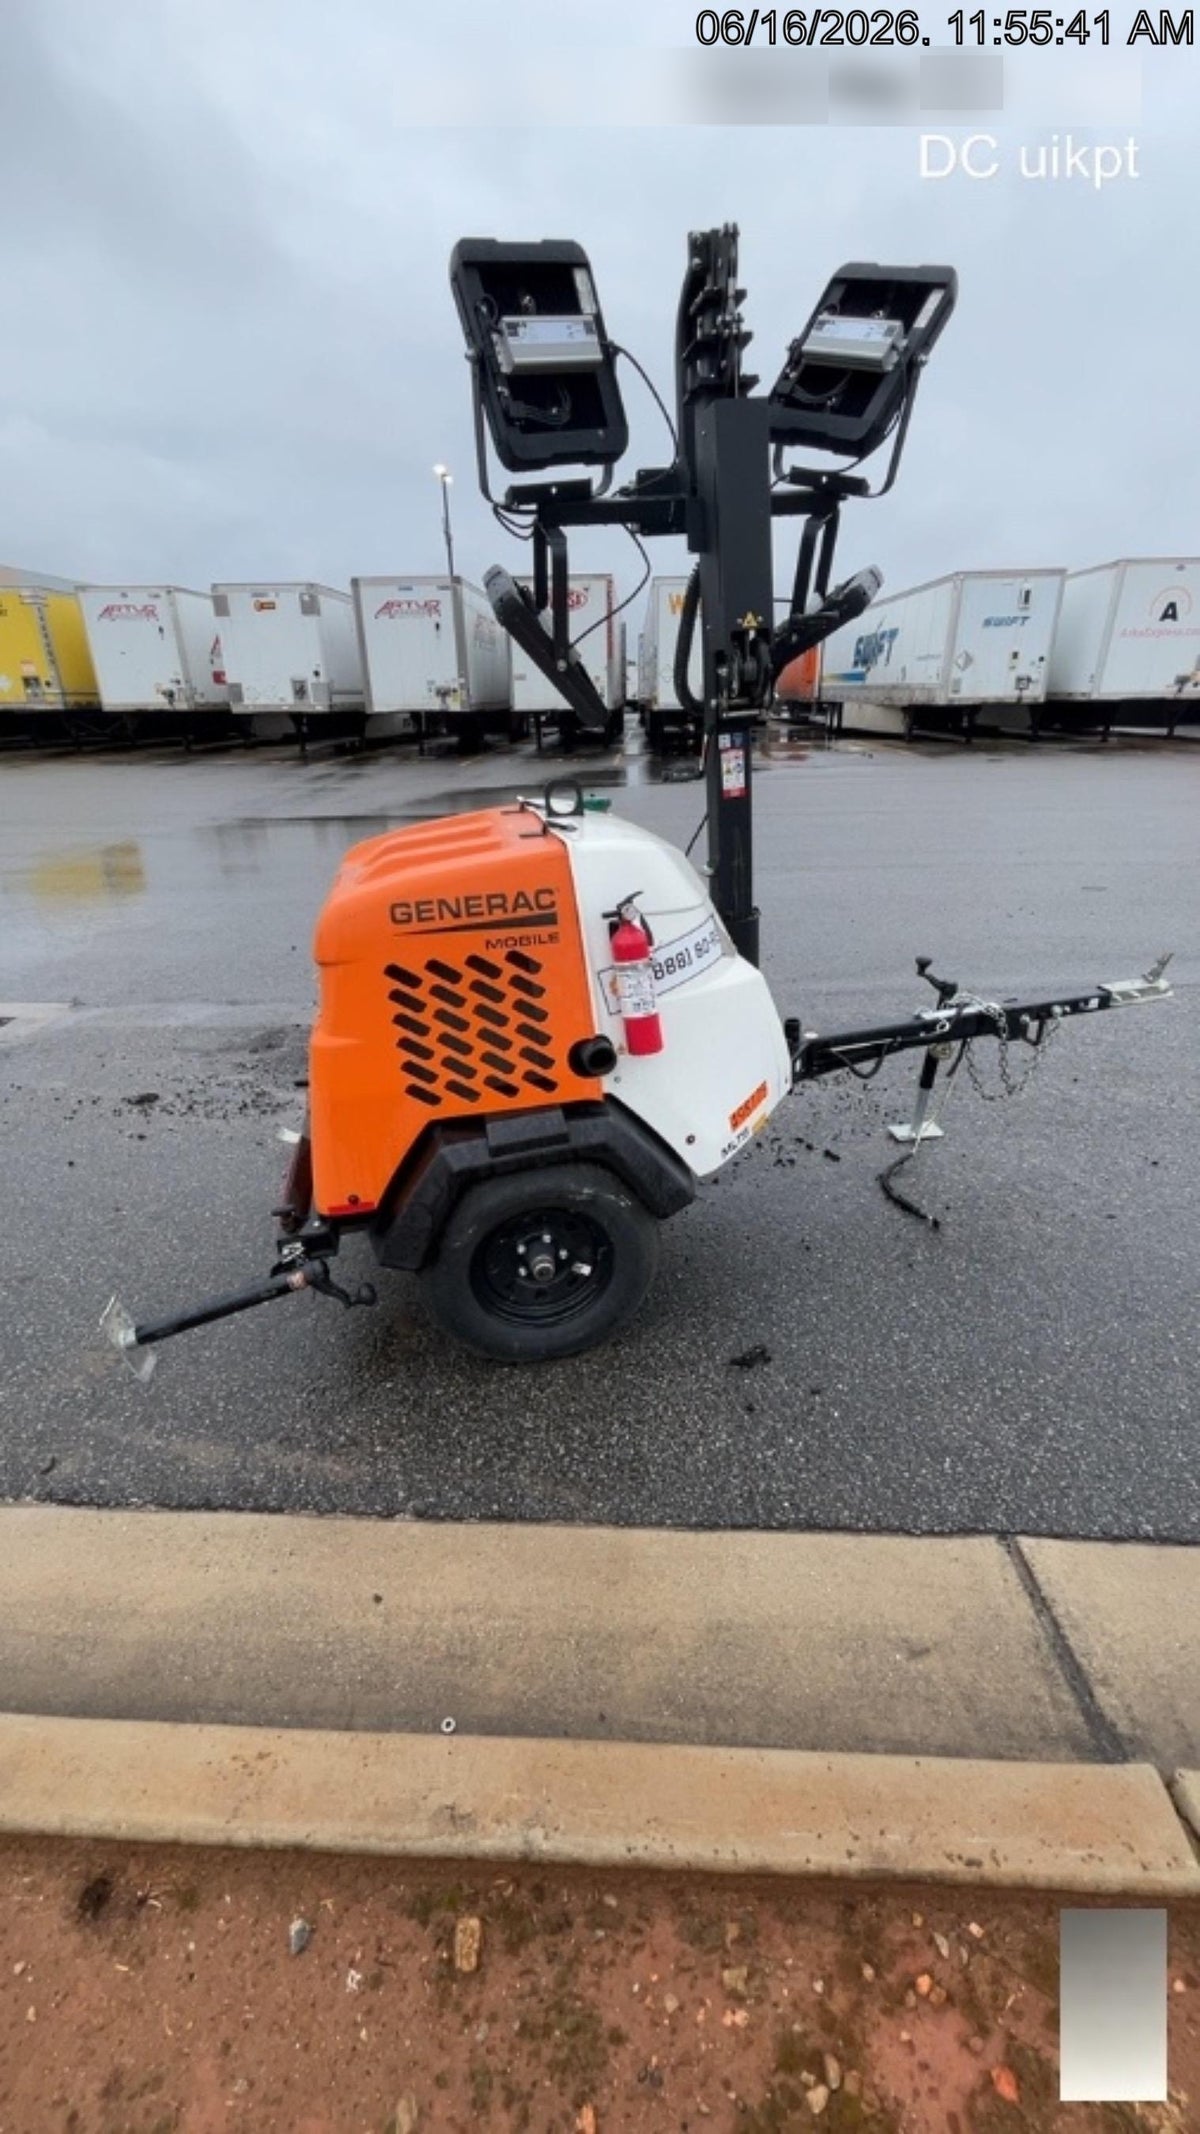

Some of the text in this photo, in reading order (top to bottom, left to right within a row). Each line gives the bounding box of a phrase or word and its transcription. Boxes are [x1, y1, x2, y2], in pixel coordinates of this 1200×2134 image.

[983, 615, 1030, 628] SWIFT
[390, 888, 556, 926] GENERAC
[485, 931, 559, 950] MOBILE
